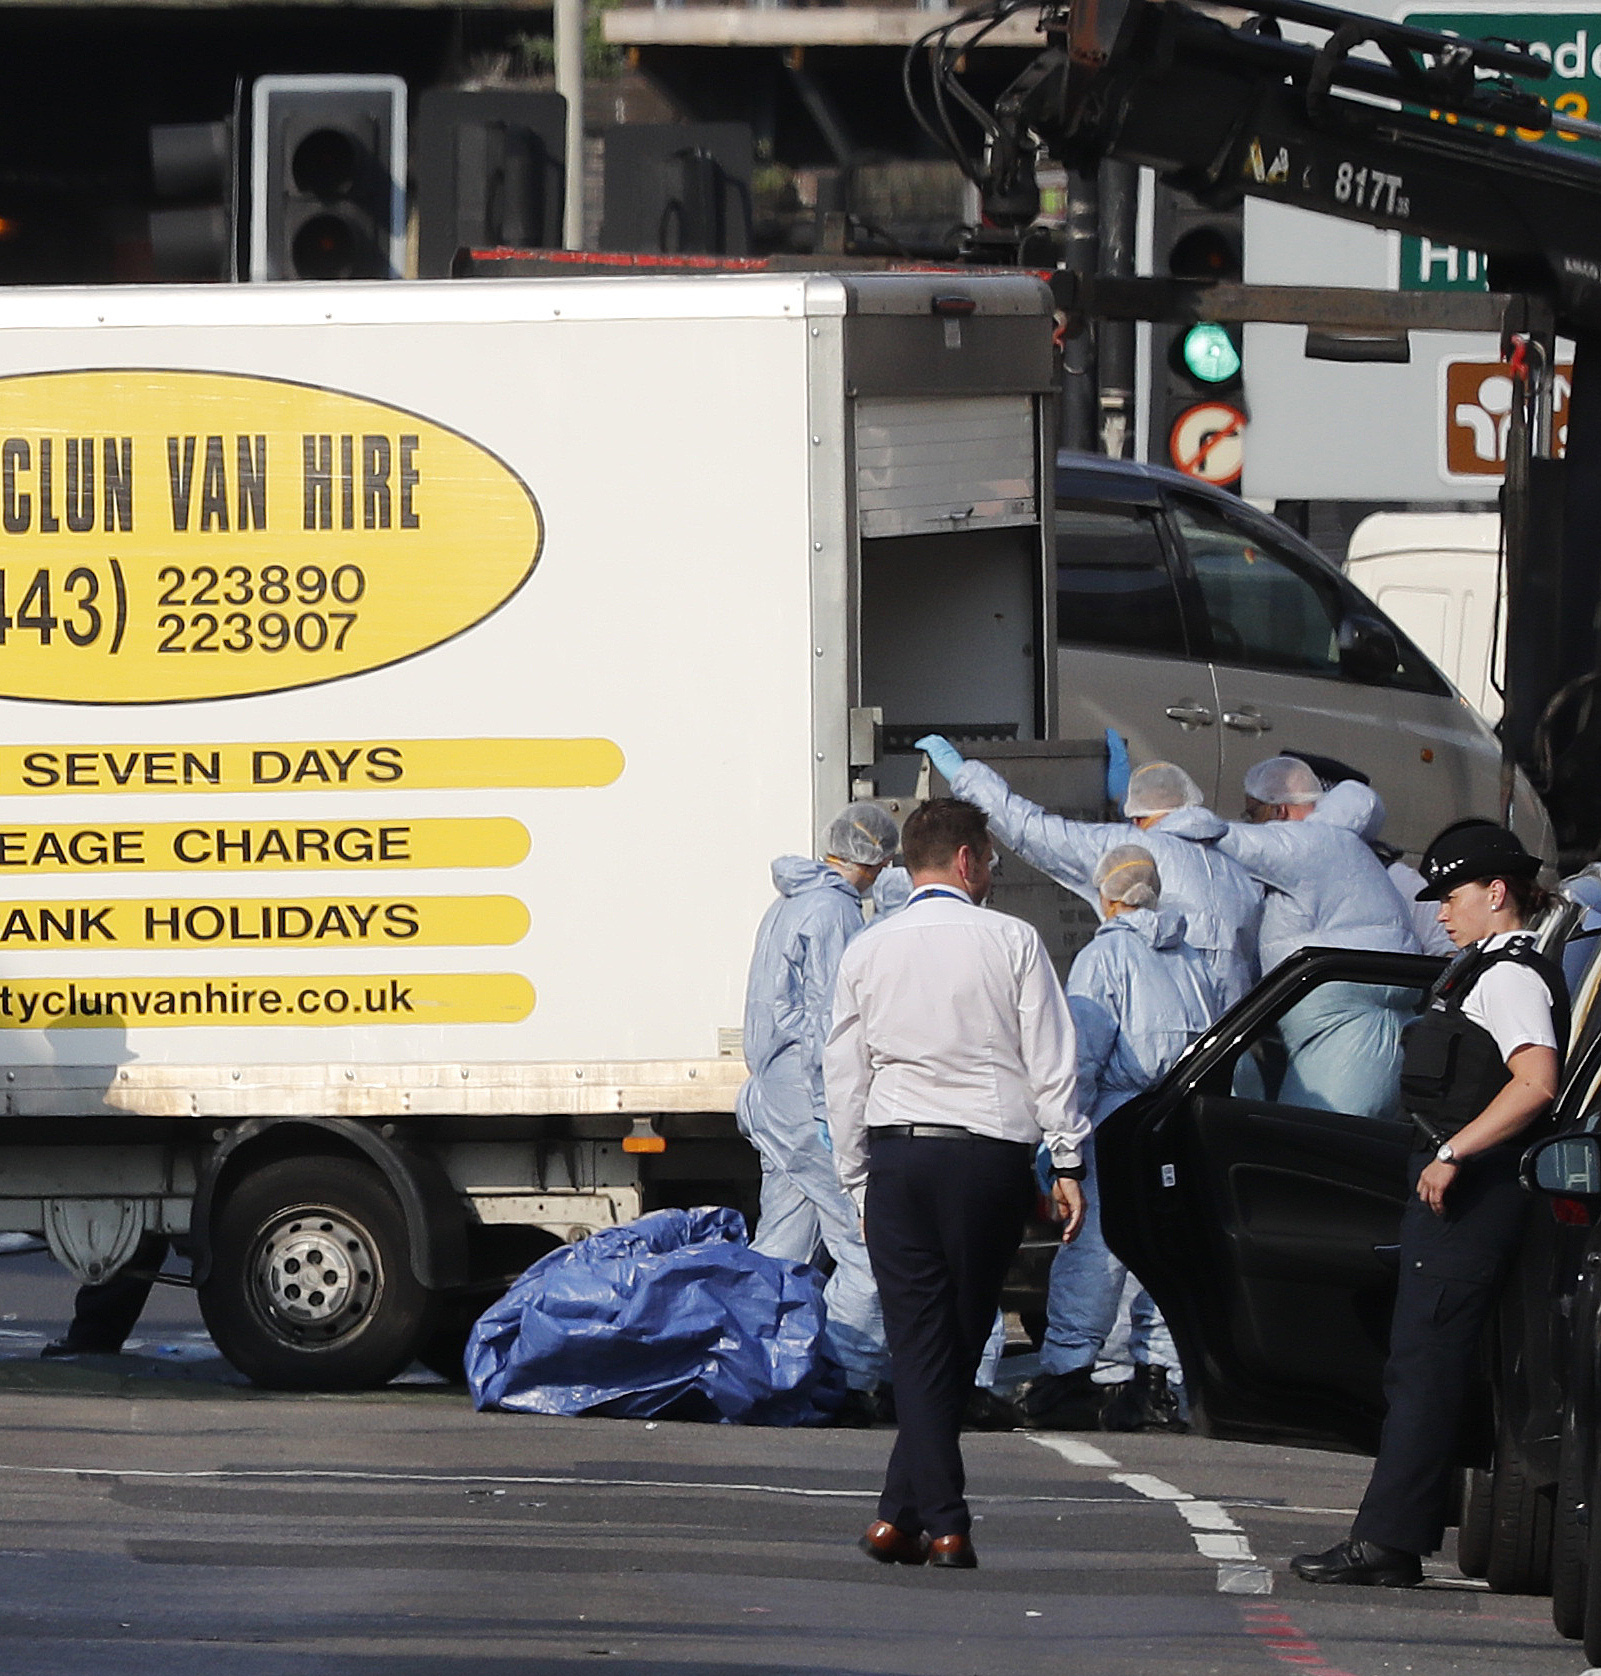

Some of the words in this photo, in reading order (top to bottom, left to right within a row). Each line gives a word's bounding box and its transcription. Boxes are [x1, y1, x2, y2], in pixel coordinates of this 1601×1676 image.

[167, 435, 267, 533] VAN
[303, 434, 421, 531] HIRE
[157, 564, 366, 606] 223890
[157, 612, 359, 654] 223907
[22, 752, 220, 787] SEVEN
[252, 747, 403, 784] DAYS
[173, 827, 410, 864] CHARGE
[145, 904, 420, 941] HOLIDAYS
